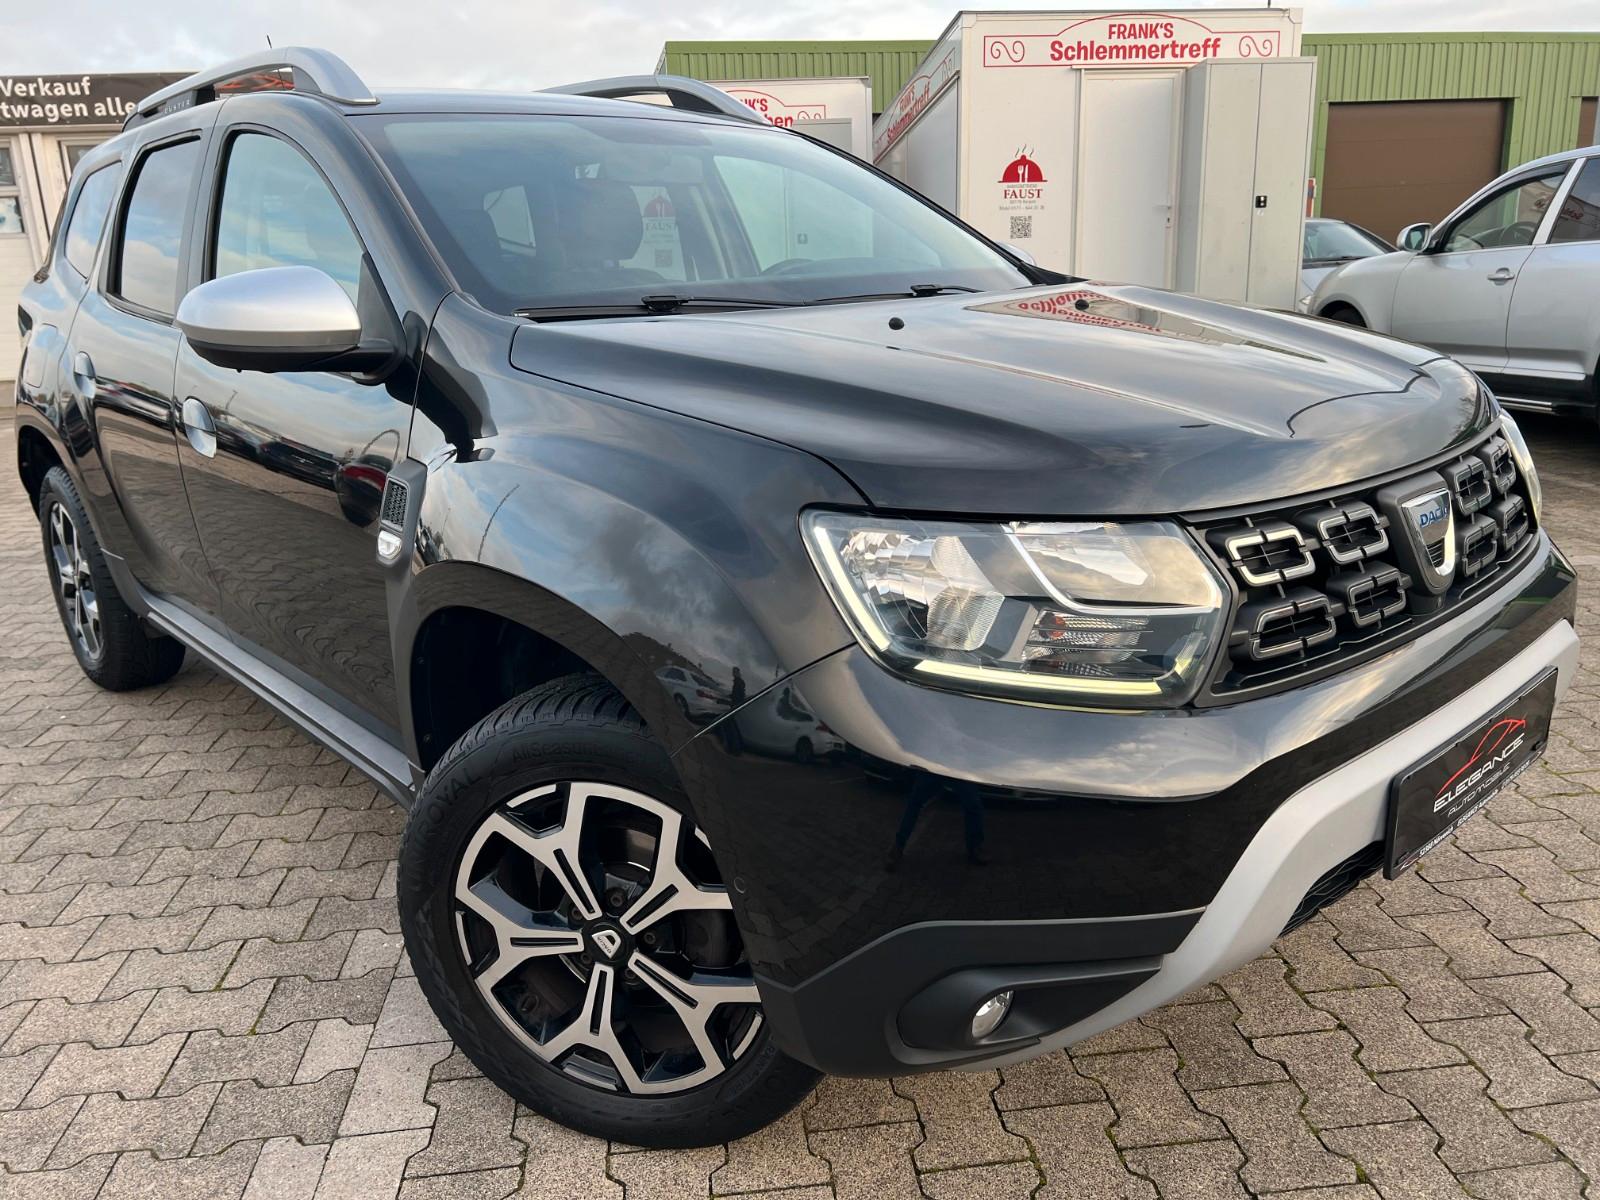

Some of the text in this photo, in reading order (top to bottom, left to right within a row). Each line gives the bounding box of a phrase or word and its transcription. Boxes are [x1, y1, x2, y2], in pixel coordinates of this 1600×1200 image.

[1108, 23, 1174, 40] FRANK'S
[1050, 38, 1221, 61] Schlemmertreff
[0, 76, 91, 97] Verkauf
[0, 100, 89, 123] twagen
[1003, 188, 1044, 199] FAUST
[1433, 733, 1525, 813] ELEGANCE
[1448, 762, 1511, 818] AUTOMOBILE
